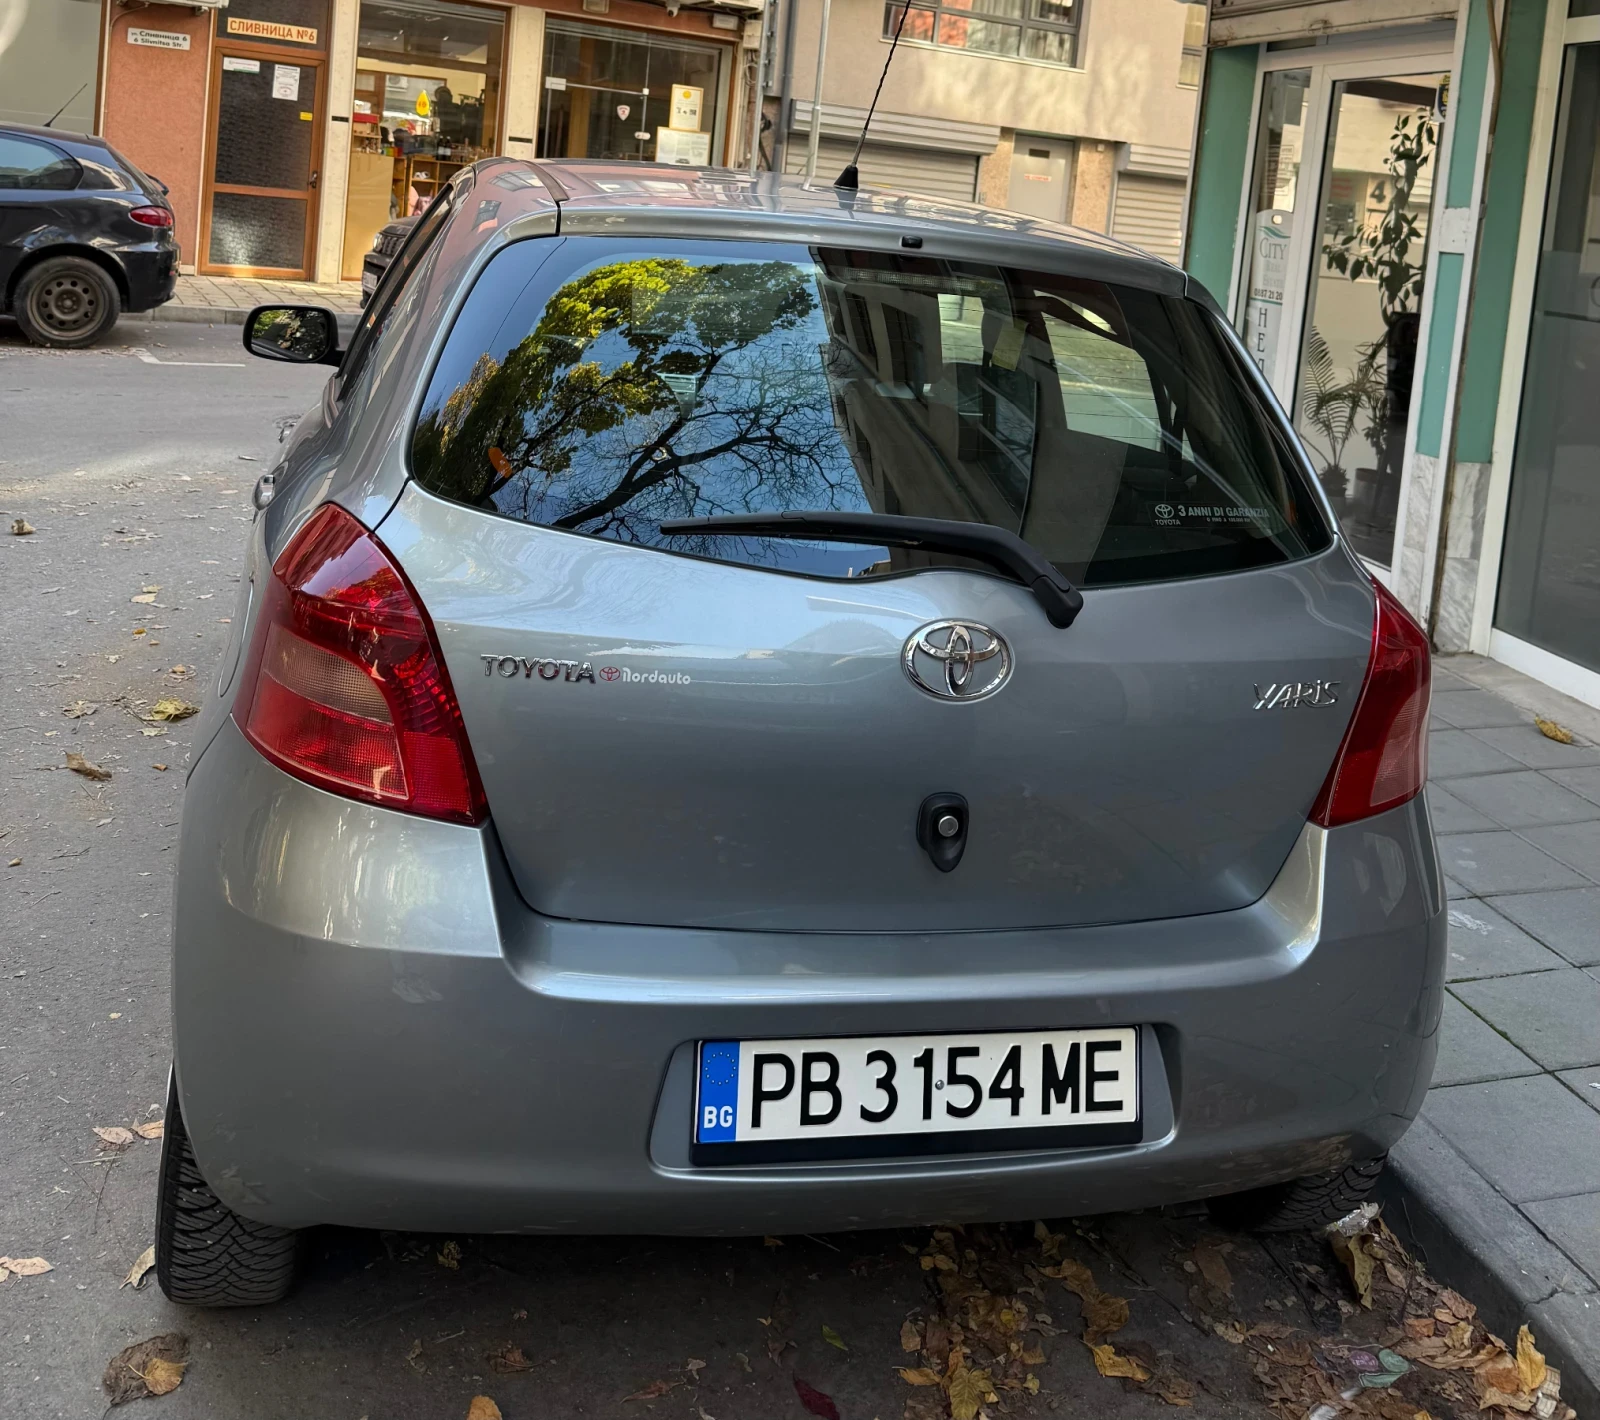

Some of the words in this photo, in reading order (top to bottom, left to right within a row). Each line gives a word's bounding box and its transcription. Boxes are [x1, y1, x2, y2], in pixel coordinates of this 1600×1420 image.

[139, 30, 180, 41] Сливница
[230, 20, 293, 39] СЛИВНИЦА
[140, 38, 170, 47] Slivnitsa
[1268, 289, 1275, 300] 21
[1177, 505, 1187, 517] 3
[1188, 506, 1212, 517] ANNI
[1213, 506, 1225, 517] DI
[1225, 507, 1270, 518] GARANZIA
[480, 653, 596, 684] TOYOTA
[750, 1050, 843, 1129] PB
[859, 1044, 1025, 1124] 3154
[1040, 1040, 1124, 1116] ME
[703, 1105, 733, 1129] BG
